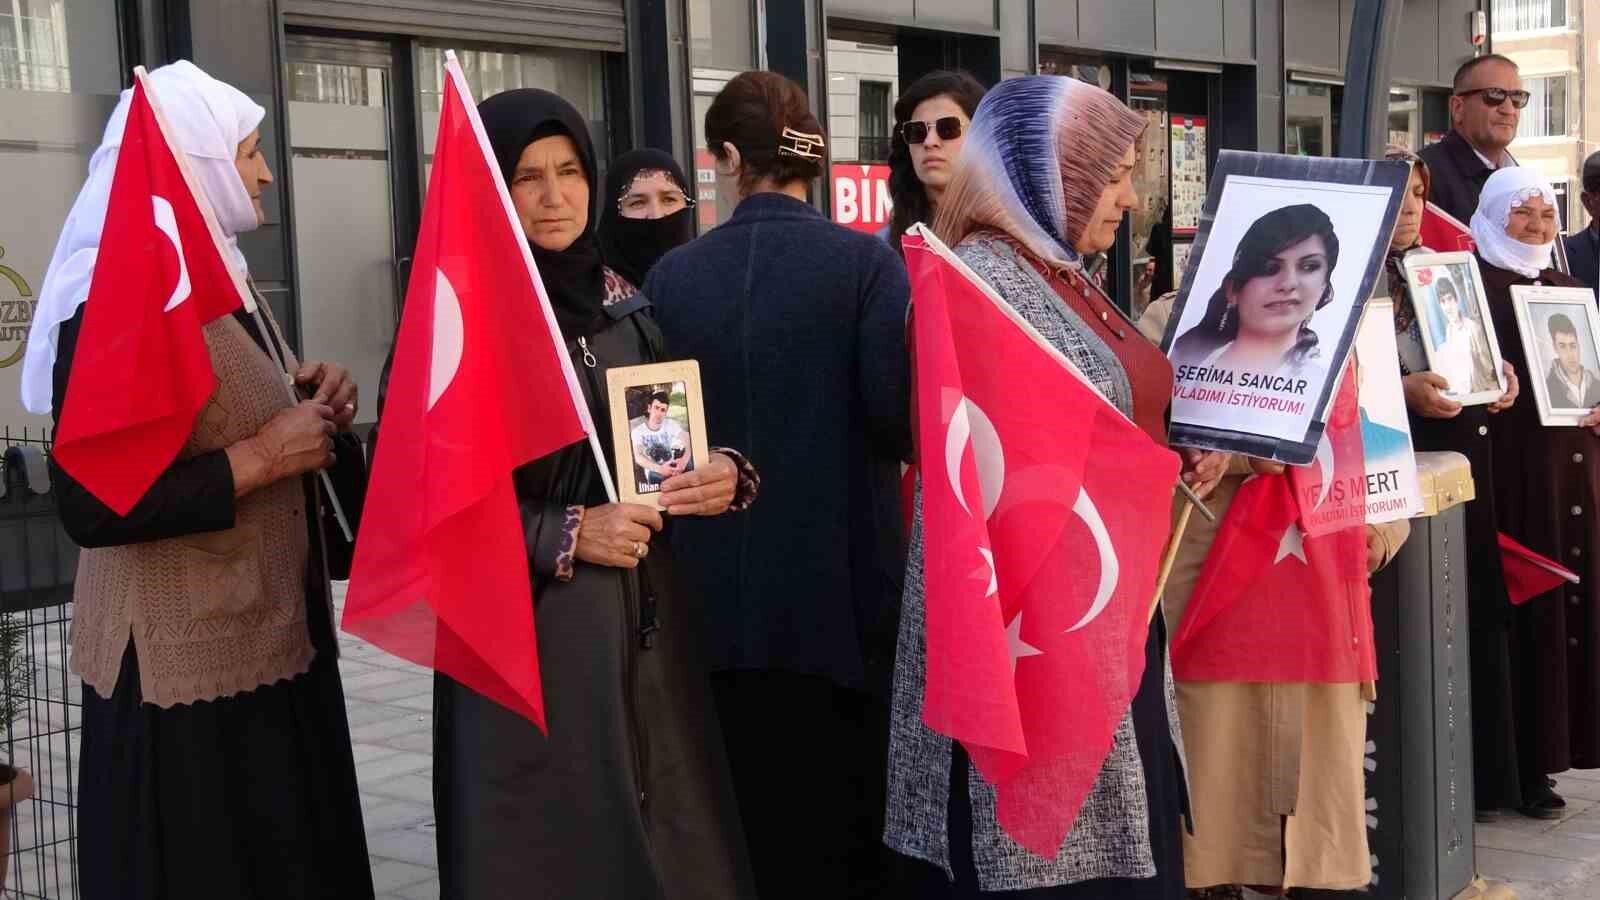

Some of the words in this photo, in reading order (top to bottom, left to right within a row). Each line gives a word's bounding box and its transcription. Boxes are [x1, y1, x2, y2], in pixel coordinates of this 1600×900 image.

[1176, 365, 1233, 385] ŞERİMA
[1239, 373, 1307, 395] SANCAR
[1227, 390, 1305, 415] İSTİYORUM!
[1350, 470, 1400, 498] MERT
